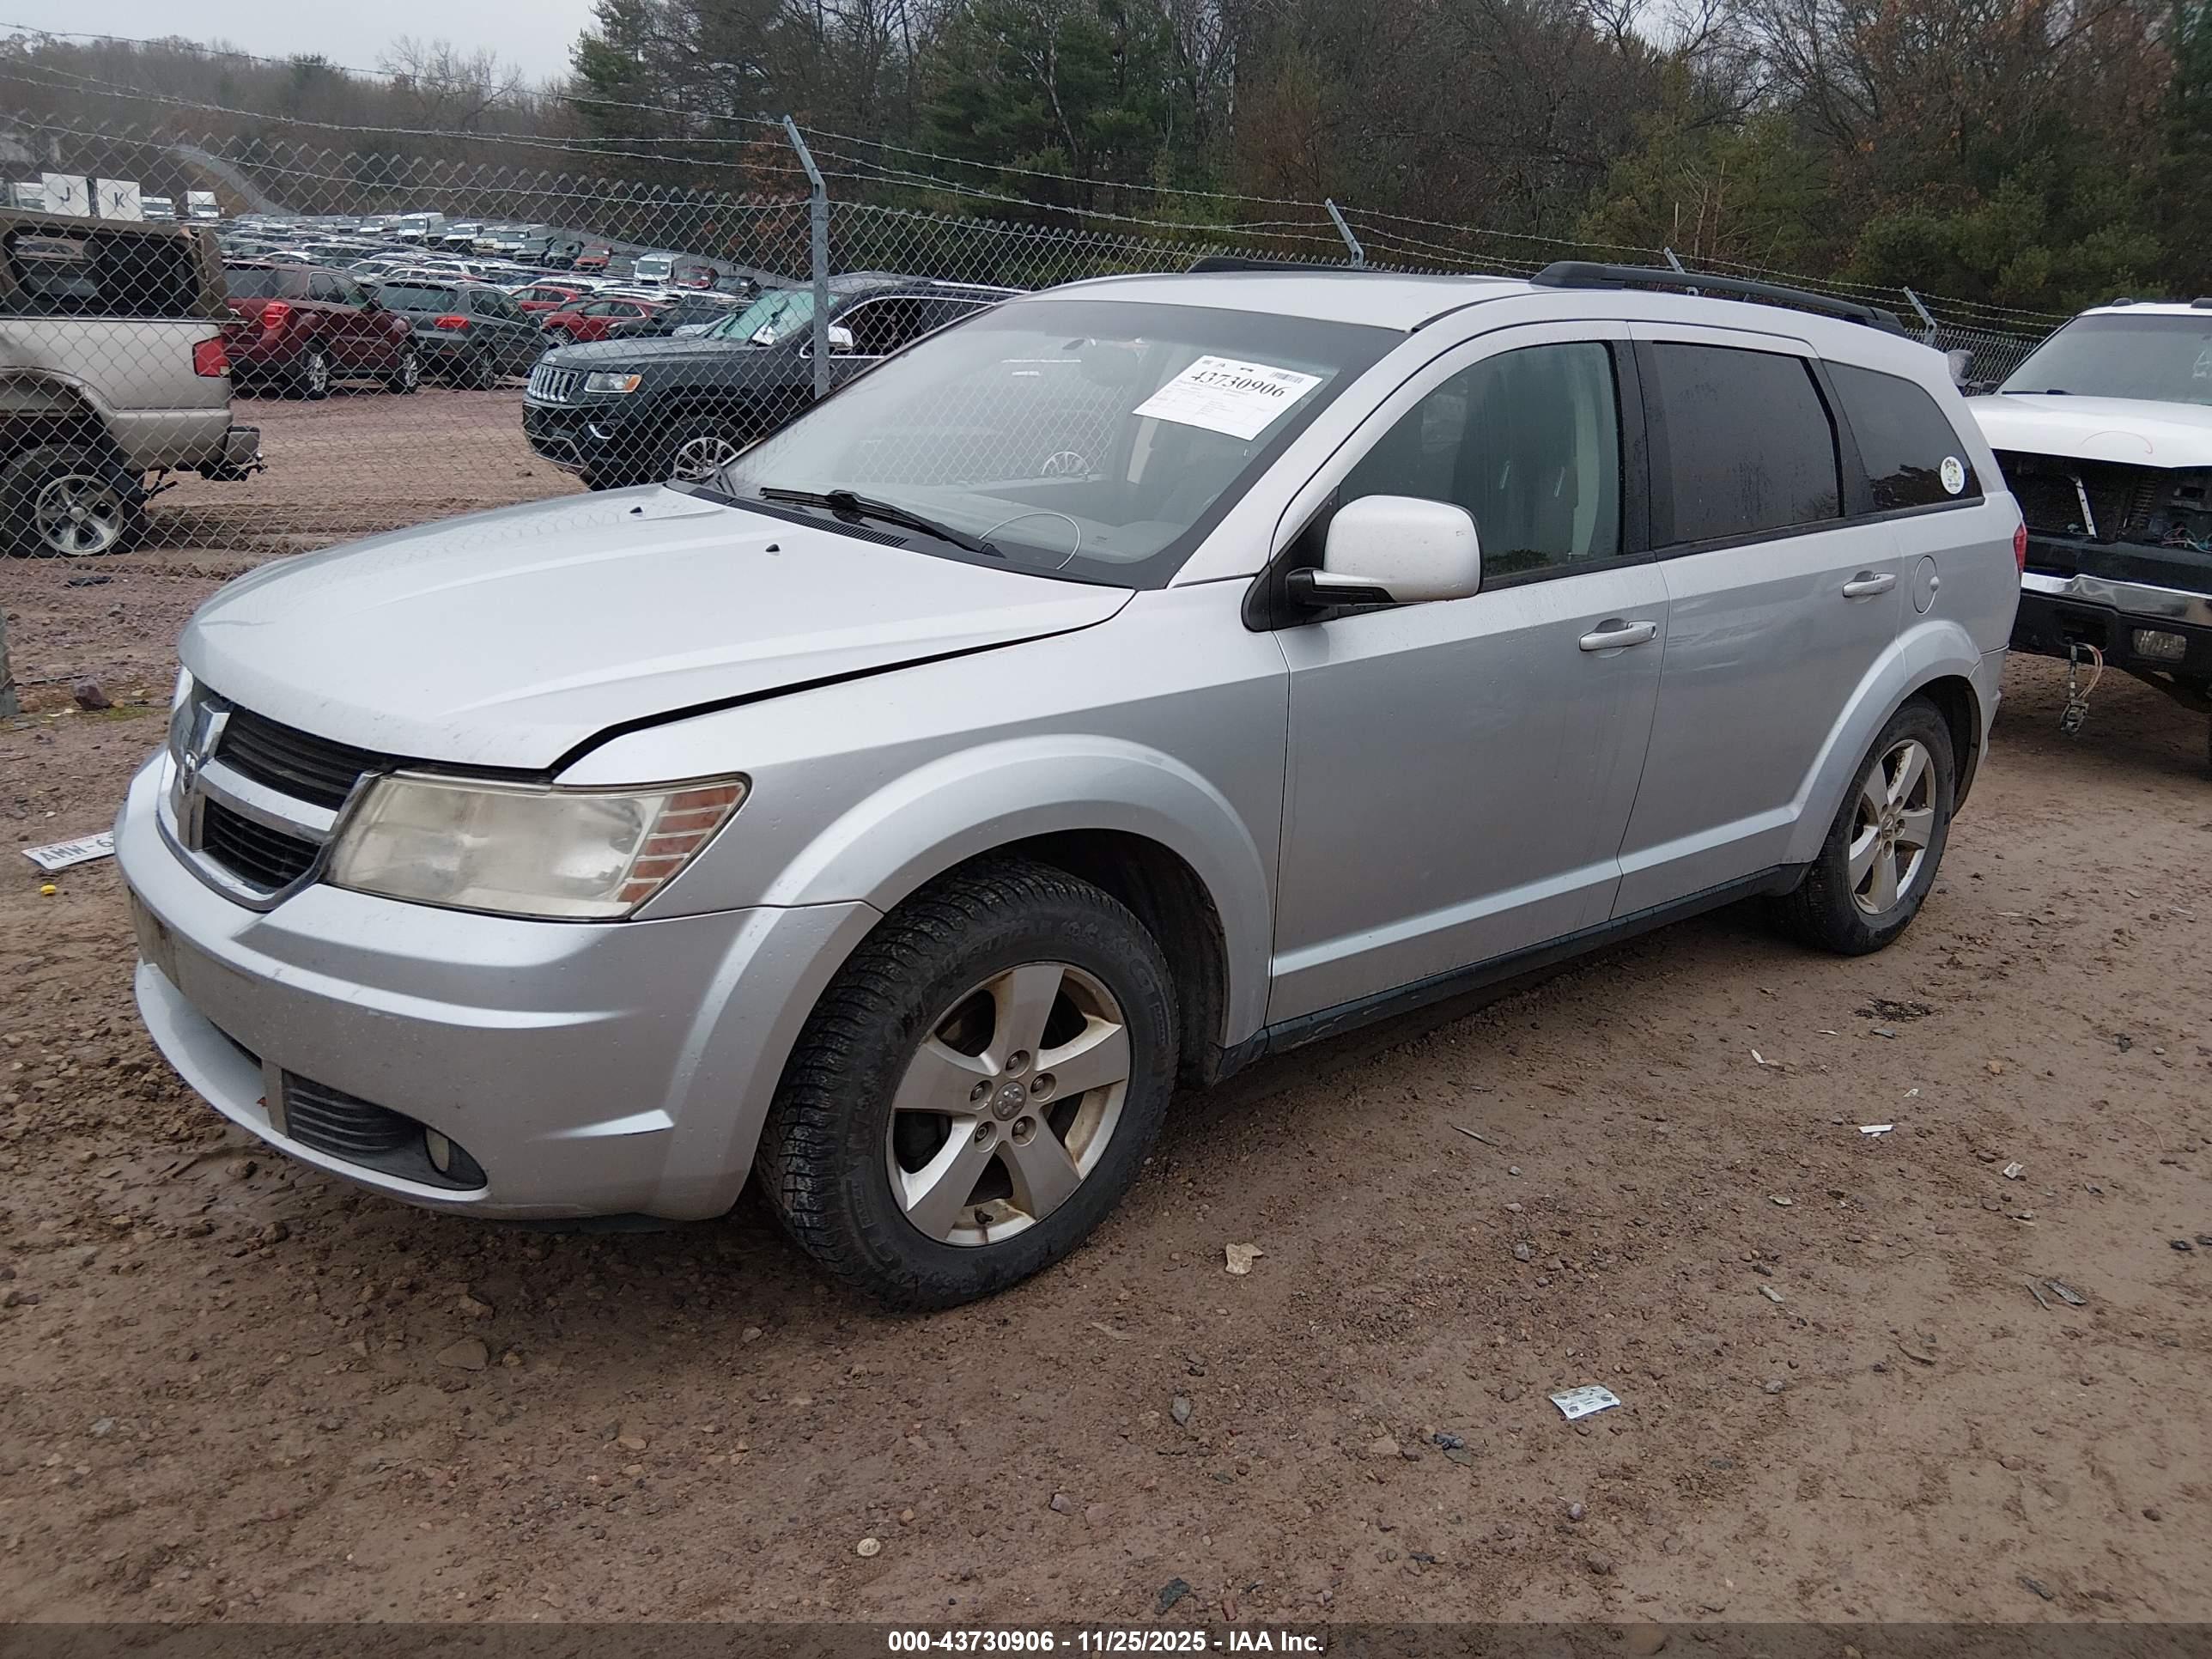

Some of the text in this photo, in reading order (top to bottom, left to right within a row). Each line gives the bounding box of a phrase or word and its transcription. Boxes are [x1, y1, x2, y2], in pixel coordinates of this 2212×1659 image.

[59, 186, 70, 202] J
[113, 191, 125, 208] K
[1190, 370, 1291, 398] 43730906
